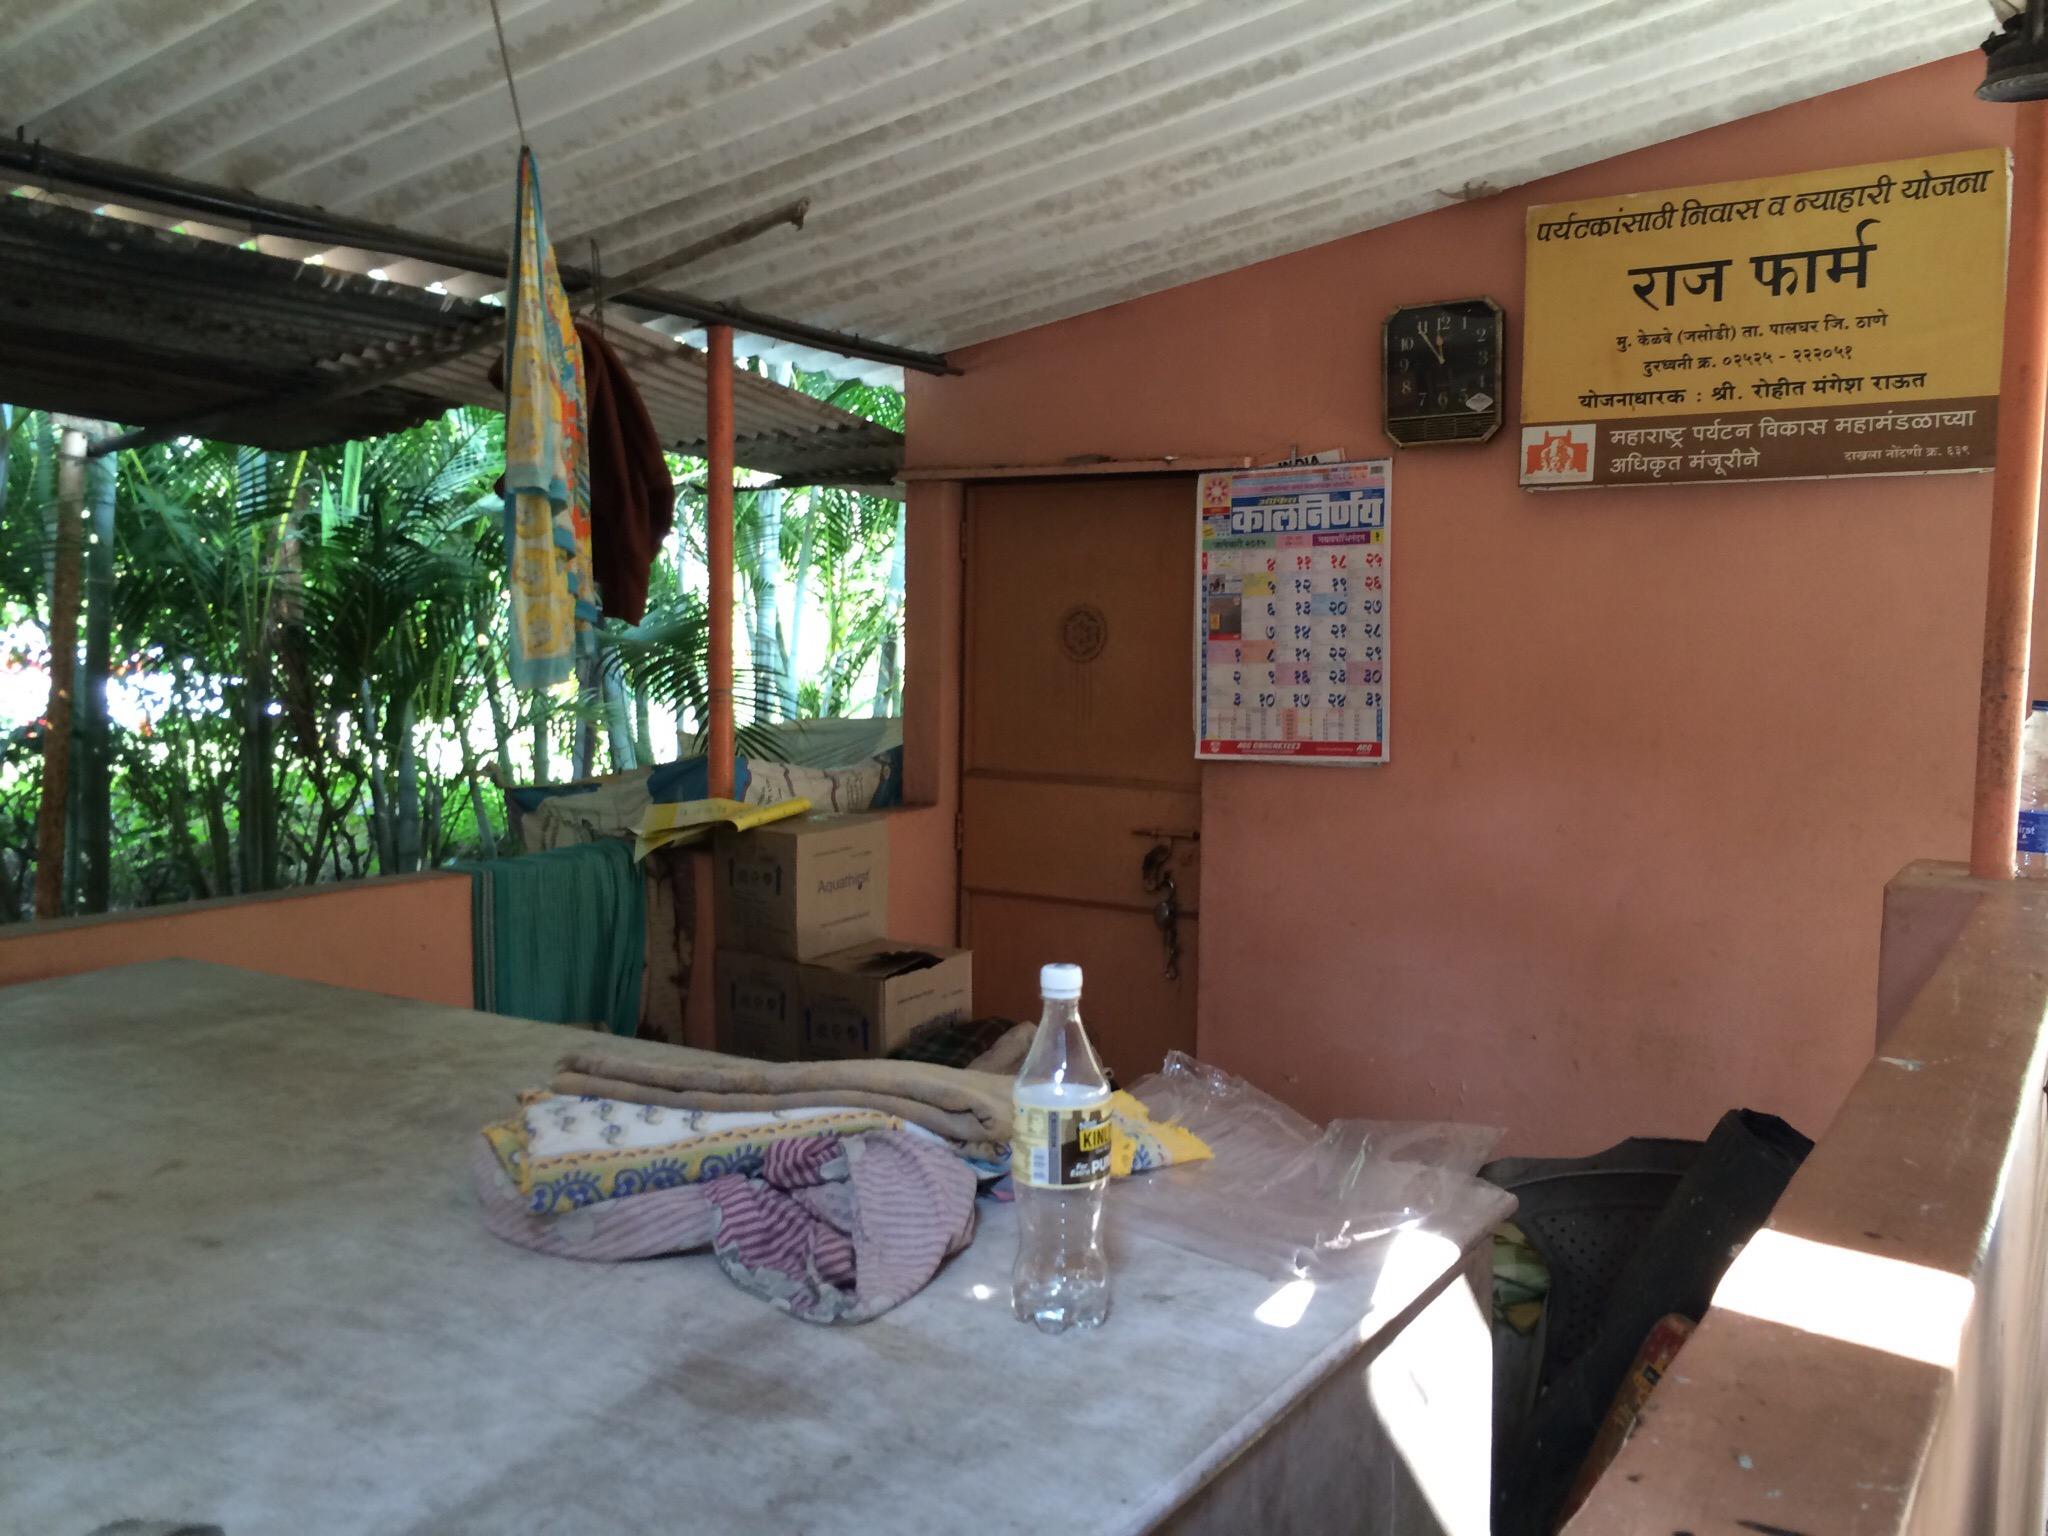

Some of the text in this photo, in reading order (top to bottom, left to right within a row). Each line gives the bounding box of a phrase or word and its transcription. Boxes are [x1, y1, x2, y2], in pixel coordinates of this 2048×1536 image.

[1537, 168, 1995, 242] पर्यटकांसाठी निवास व न्याहारी योजना
[1629, 218, 1881, 311] राज फार्म
[1638, 327, 1673, 346] केळवे
[1742, 322, 1763, 338] ता.
[1770, 317, 1819, 335] पालघर
[1823, 313, 1850, 331] जि.
[1854, 309, 1888, 329] ठाणे
[1696, 355, 1716, 370] क्र.
[1722, 351, 1772, 367] ०२५२५
[1791, 345, 1853, 364] २२२०५१
[1579, 388, 1687, 409] योजनाधारक
[1711, 380, 1743, 401] श्री.
[1752, 376, 1807, 399] रोहीत
[1812, 374, 1863, 395] मंगेश
[1872, 371, 1927, 391] राऊत
[1610, 408, 1975, 449] महाराष्ट्र पर्यटन विकास महामंडळाच्या
[1610, 446, 1760, 477] अधिकृत मंजूरीने
[1231, 491, 1384, 534] कालनिर्णय
